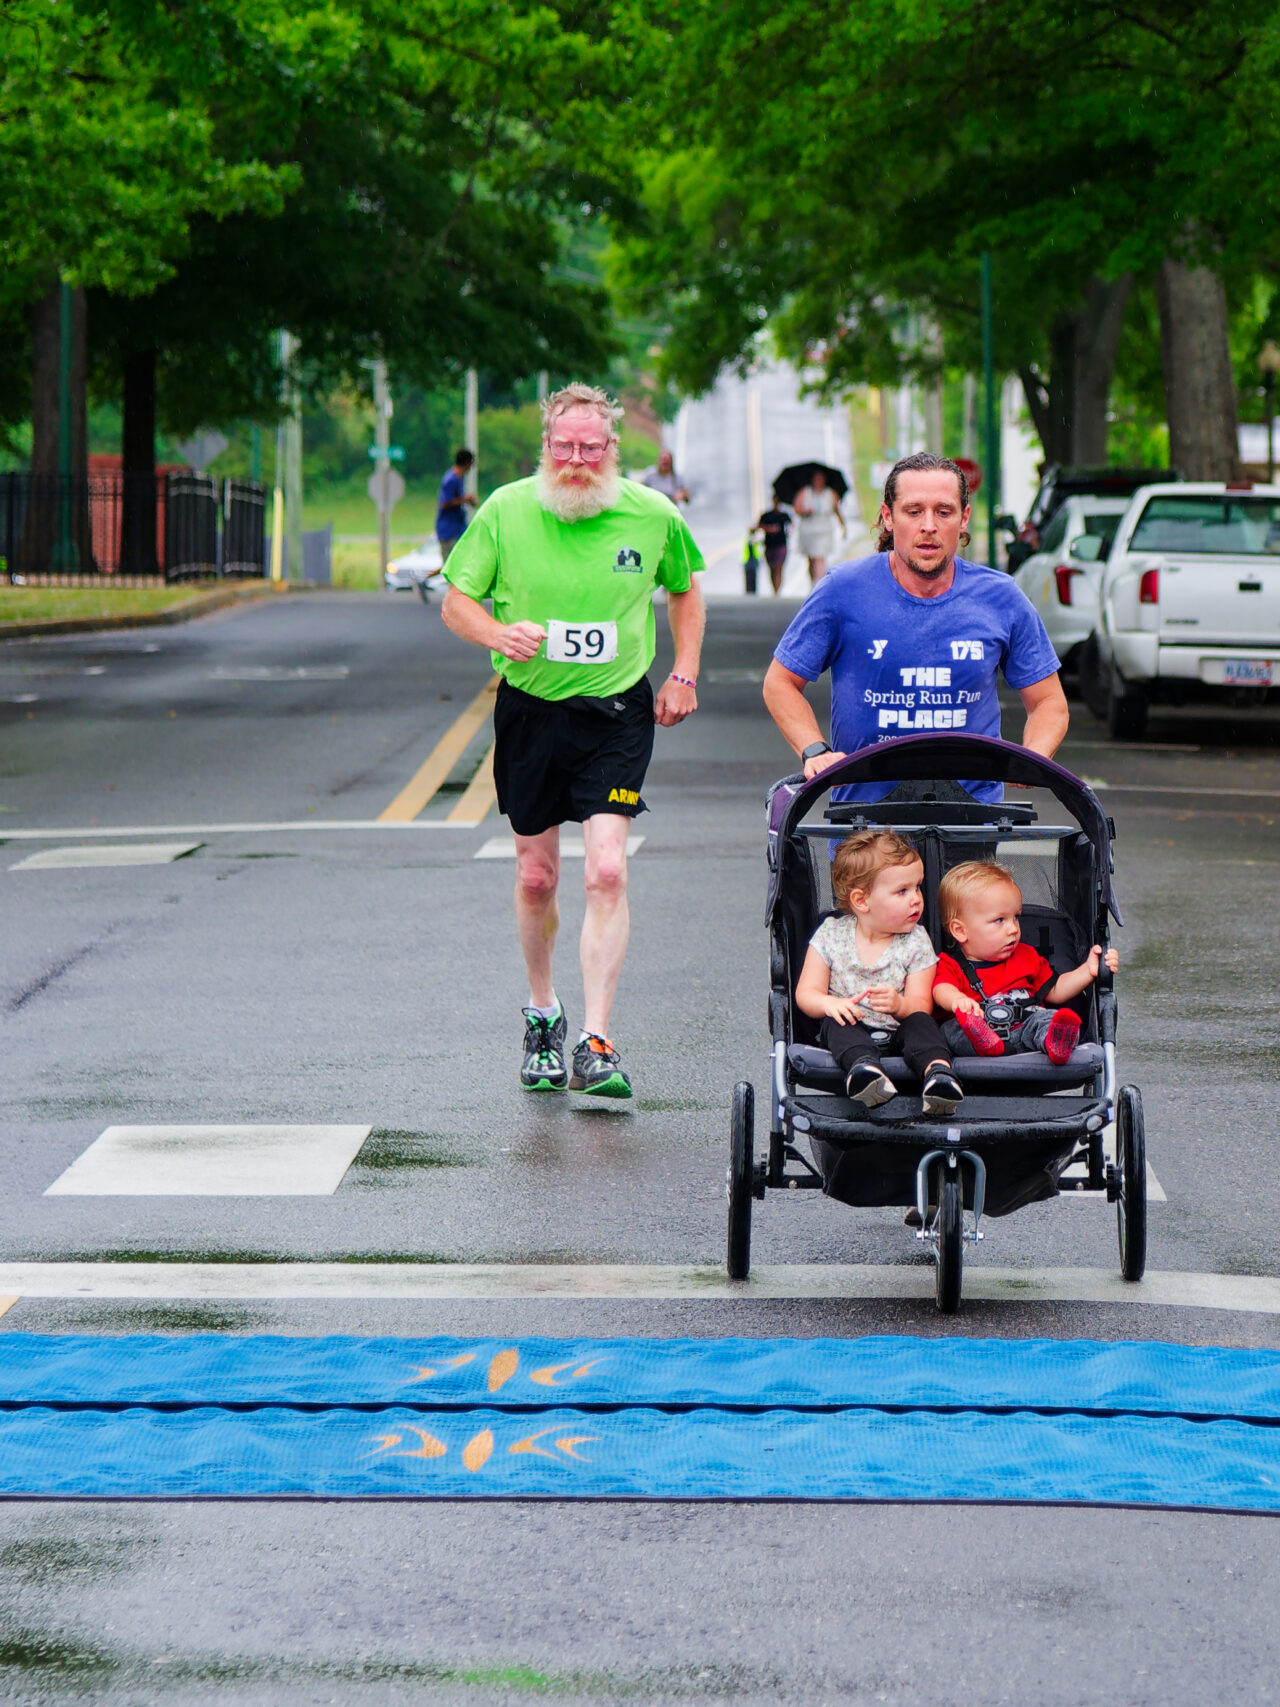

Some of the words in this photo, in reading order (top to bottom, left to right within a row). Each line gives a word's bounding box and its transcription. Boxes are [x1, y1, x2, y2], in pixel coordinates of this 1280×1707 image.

[564, 629, 605, 658] 59
[950, 640, 982, 660] 175
[900, 667, 951, 687] THE
[864, 689, 916, 708] Spring
[919, 690, 953, 704] Run
[956, 690, 981, 703] Fun
[878, 709, 967, 728] PLACE
[608, 787, 639, 806] ARMY
